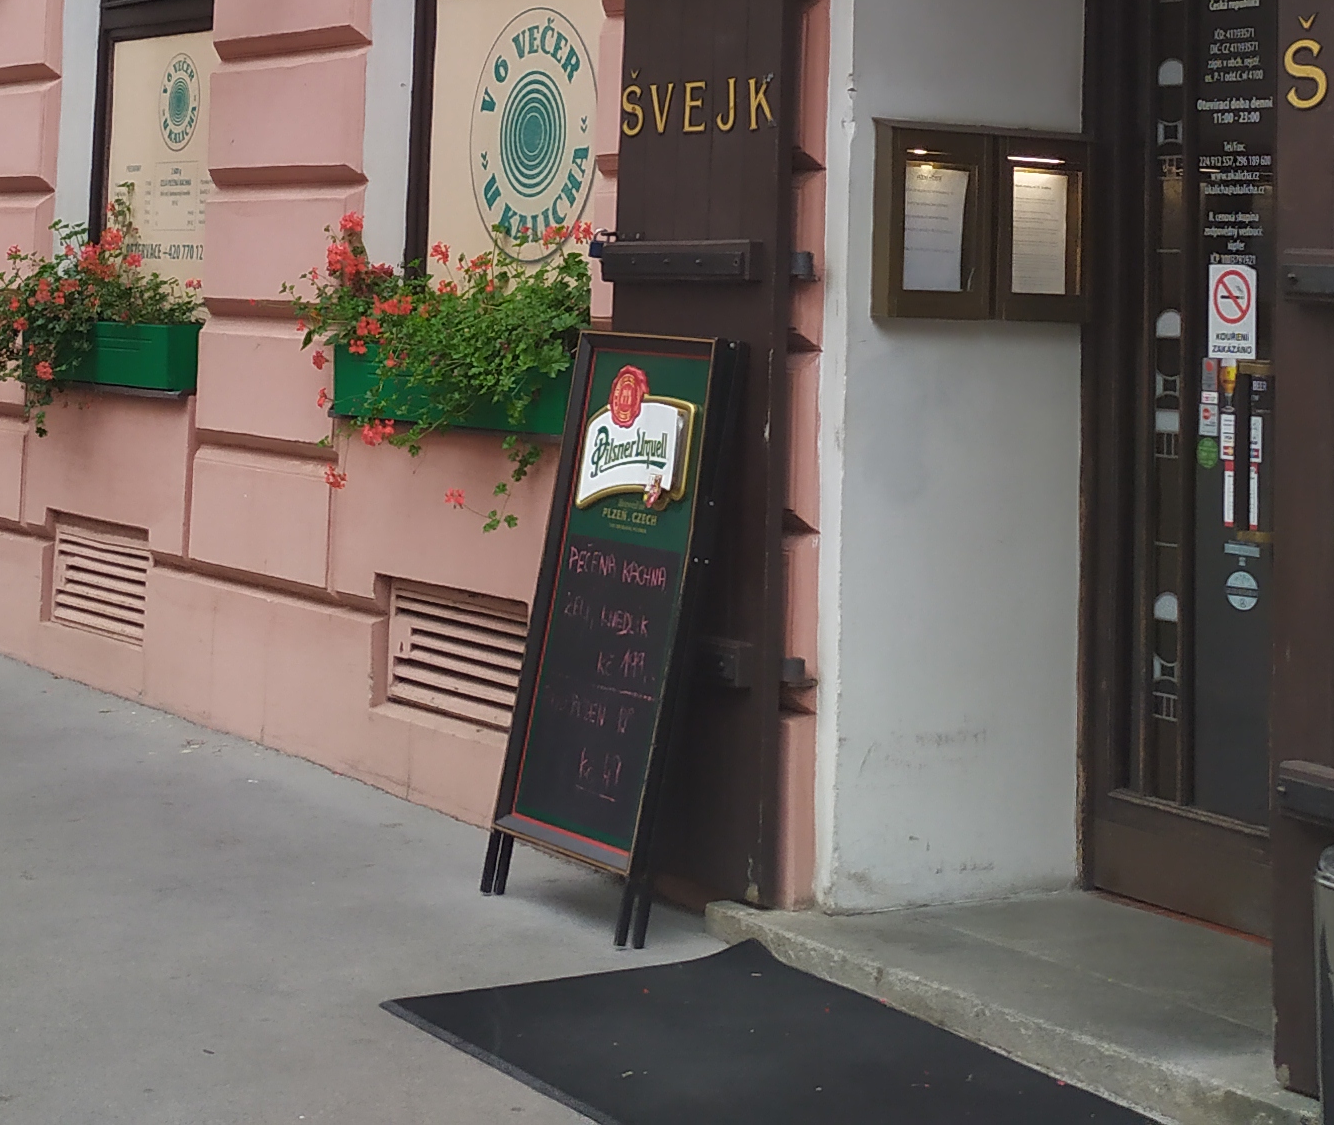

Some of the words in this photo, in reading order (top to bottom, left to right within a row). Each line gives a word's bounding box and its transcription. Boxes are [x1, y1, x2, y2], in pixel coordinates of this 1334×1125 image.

[480, 86, 498, 114] V
[493, 54, 509, 84] 6
[512, 17, 581, 84] VEČER
[622, 69, 774, 137] ŠVEJK
[483, 173, 502, 212] U
[196, 244, 204, 260] 12
[591, 426, 637, 478] Pilsner
[637, 427, 668, 469] Urquell
[632, 512, 658, 526] CZECH
